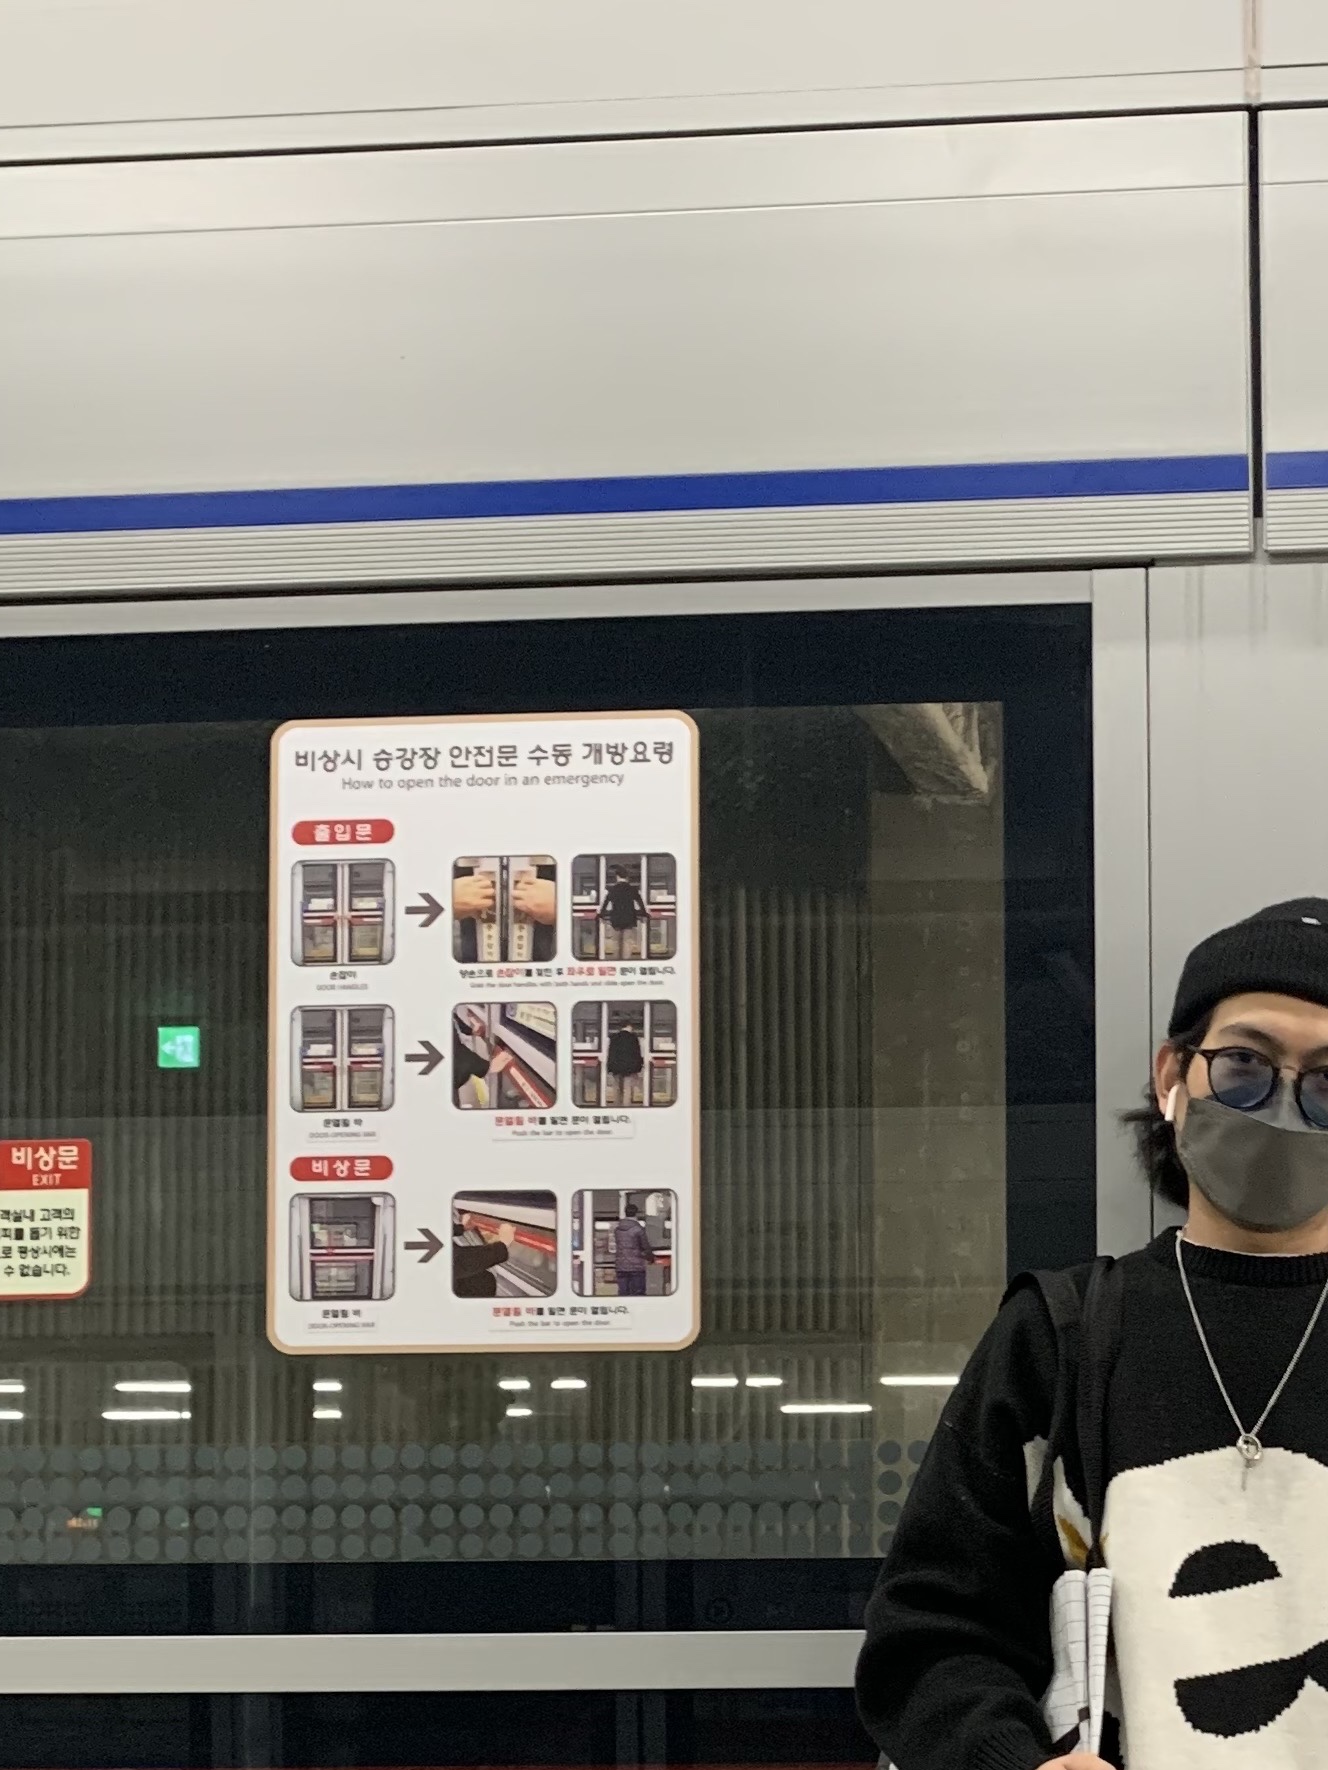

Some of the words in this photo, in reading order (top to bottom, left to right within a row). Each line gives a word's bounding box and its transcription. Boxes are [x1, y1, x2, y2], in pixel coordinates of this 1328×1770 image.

[295, 748, 363, 773] 비상시
[373, 747, 441, 771] 승강장
[450, 745, 518, 769] 안전문
[527, 743, 572, 767] 수동
[582, 741, 674, 765] 개방요령
[341, 777, 375, 790] How
[379, 777, 394, 789] to
[398, 777, 434, 791] open
[439, 775, 462, 788] the
[467, 774, 500, 787] door
[504, 774, 517, 786] in
[522, 775, 540, 786] an
[544, 773, 625, 788] emergency
[314, 823, 372, 842] 출입문
[11, 1145, 80, 1171] 비상문
[311, 1158, 371, 1178] 비상문
[32, 1173, 62, 1186] EXIT
